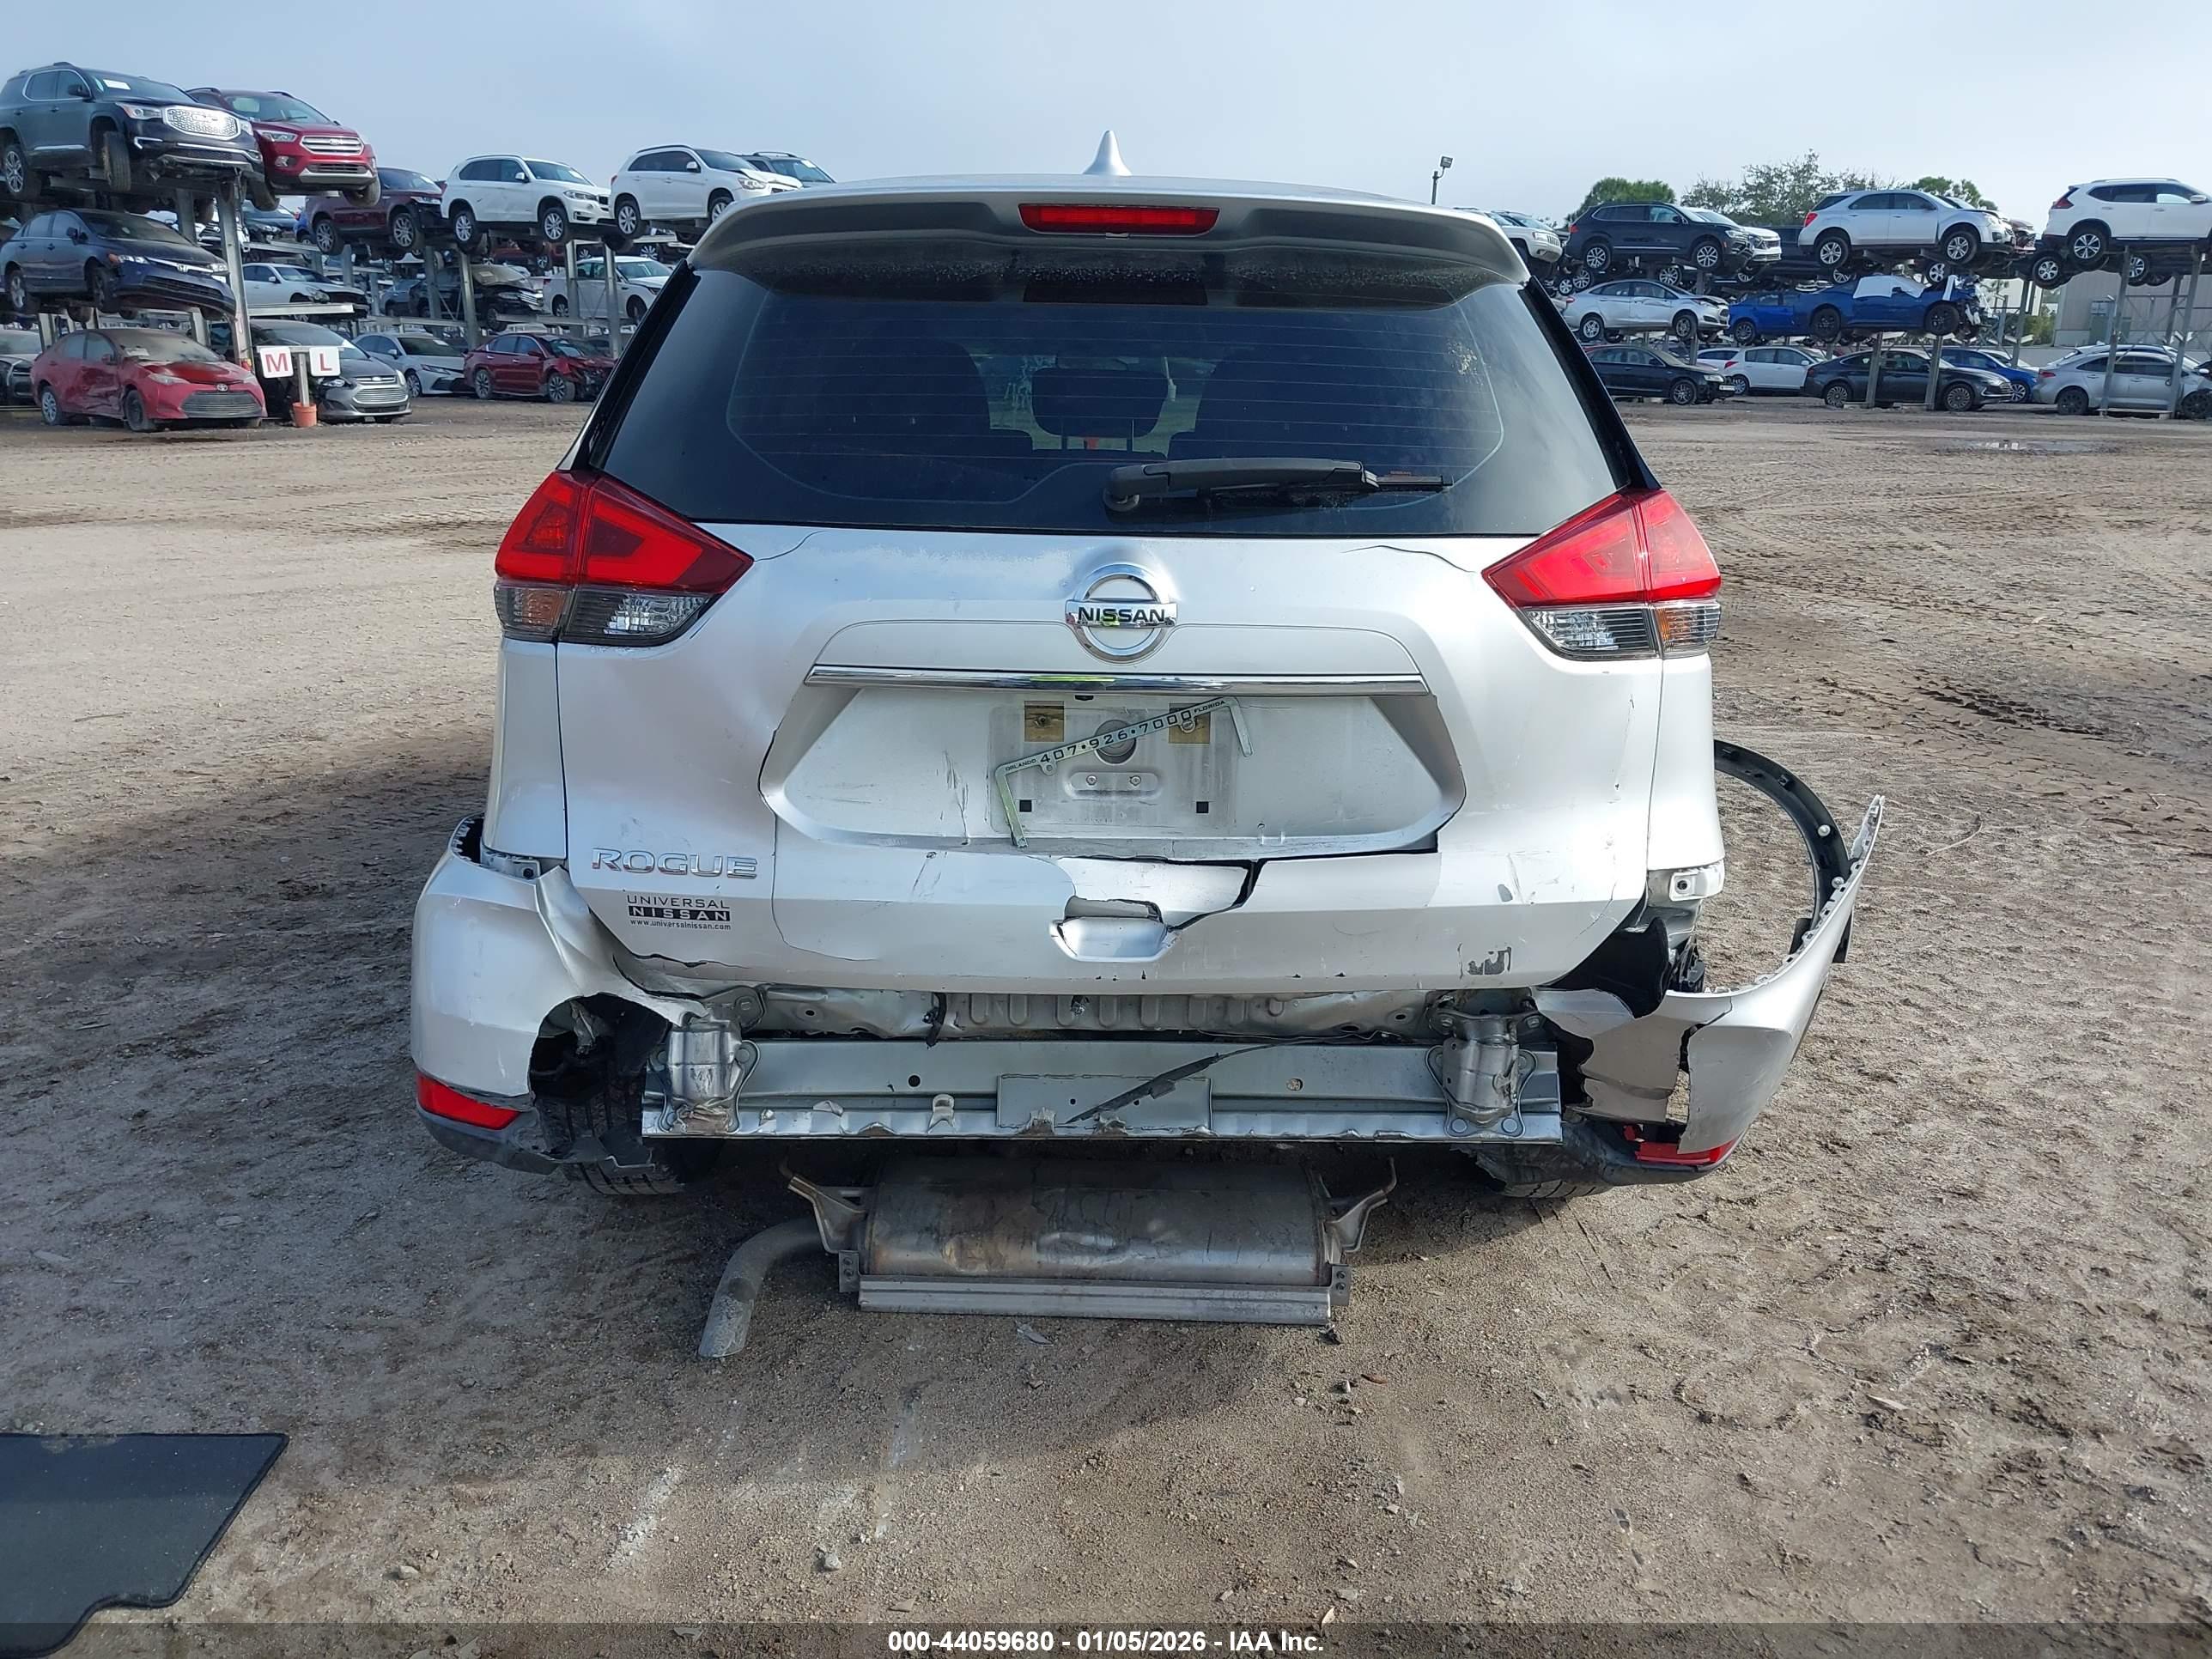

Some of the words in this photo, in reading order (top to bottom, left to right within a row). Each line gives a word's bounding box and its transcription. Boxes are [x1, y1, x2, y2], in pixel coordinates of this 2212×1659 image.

[264, 353, 289, 373] M
[319, 353, 332, 371] L
[1077, 606, 1165, 623] NISSAN
[1005, 758, 1037, 771] ORLANDO
[1194, 699, 1226, 714] FLORIDA
[591, 848, 758, 879] ROGUE
[627, 895, 730, 909] UNIVERSAL
[632, 906, 727, 921] NISSAN
[629, 919, 732, 930] www.universalnissan.com
